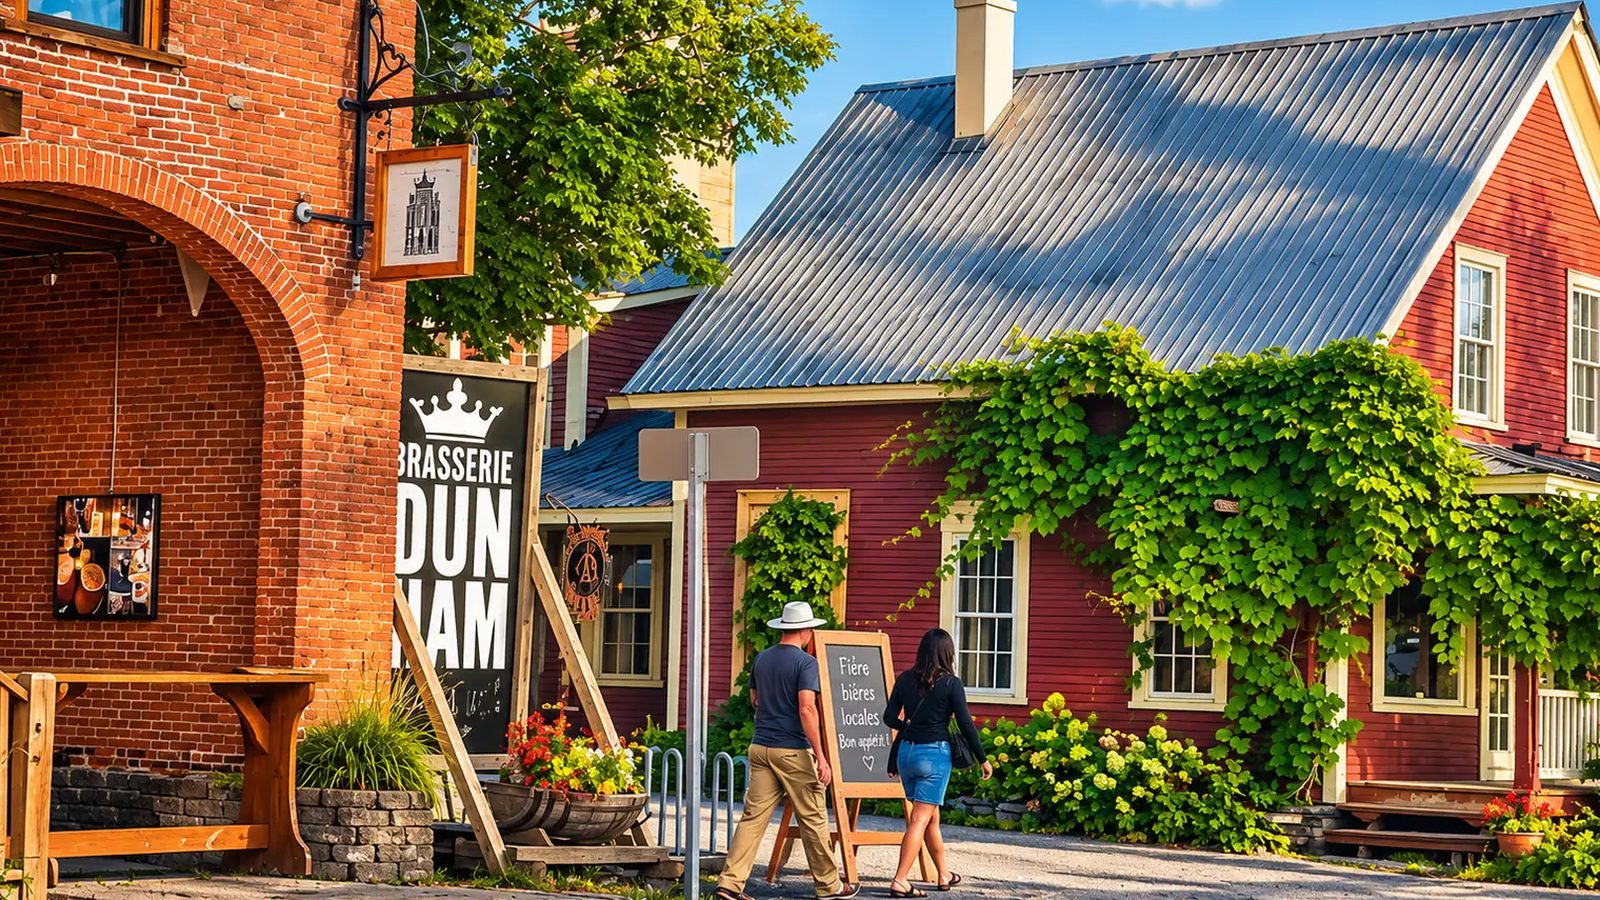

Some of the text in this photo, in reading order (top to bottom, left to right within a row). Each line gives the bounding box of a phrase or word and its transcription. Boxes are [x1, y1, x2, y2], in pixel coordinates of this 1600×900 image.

[396, 482, 512, 579] DUN
[841, 706, 880, 726] locales
[838, 733, 857, 749] Bon
